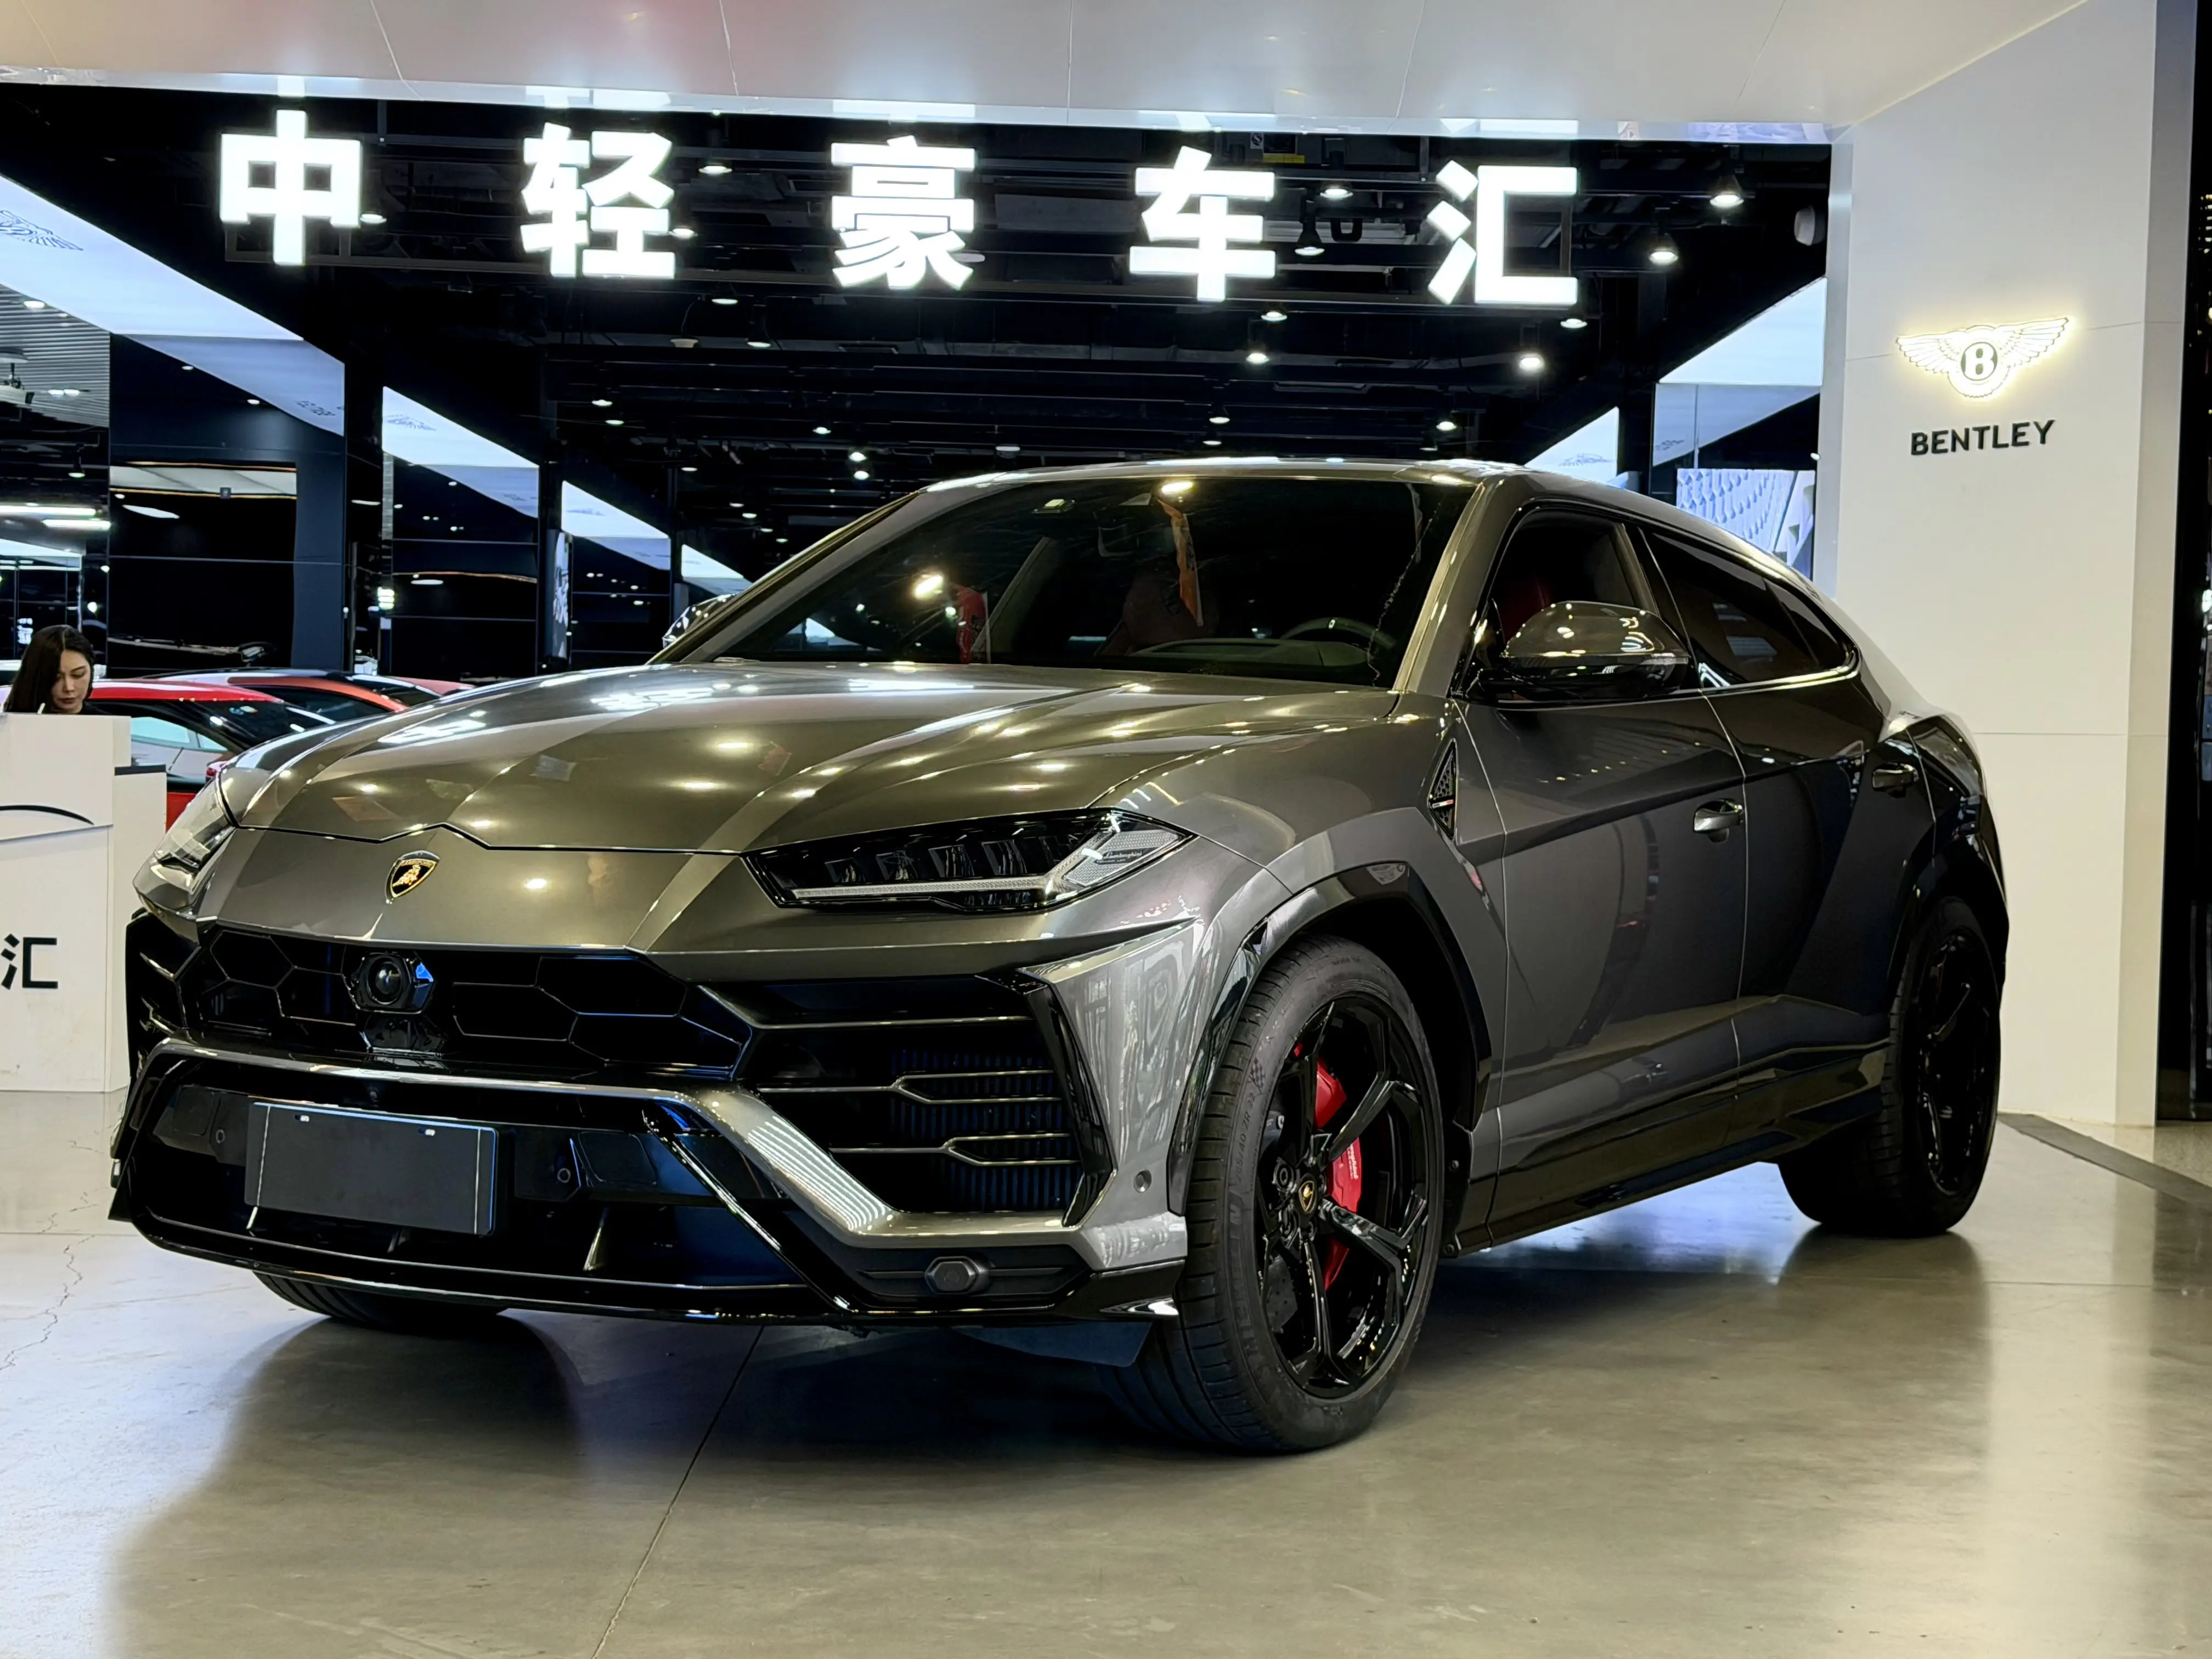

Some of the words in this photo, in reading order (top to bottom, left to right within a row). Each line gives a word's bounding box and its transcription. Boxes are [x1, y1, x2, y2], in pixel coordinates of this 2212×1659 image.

[219, 109, 1578, 304] 中轻豪车汇
[1962, 342, 1996, 380] B
[1911, 419, 2055, 456] BENTLEY
[0, 933, 58, 990] 汇
